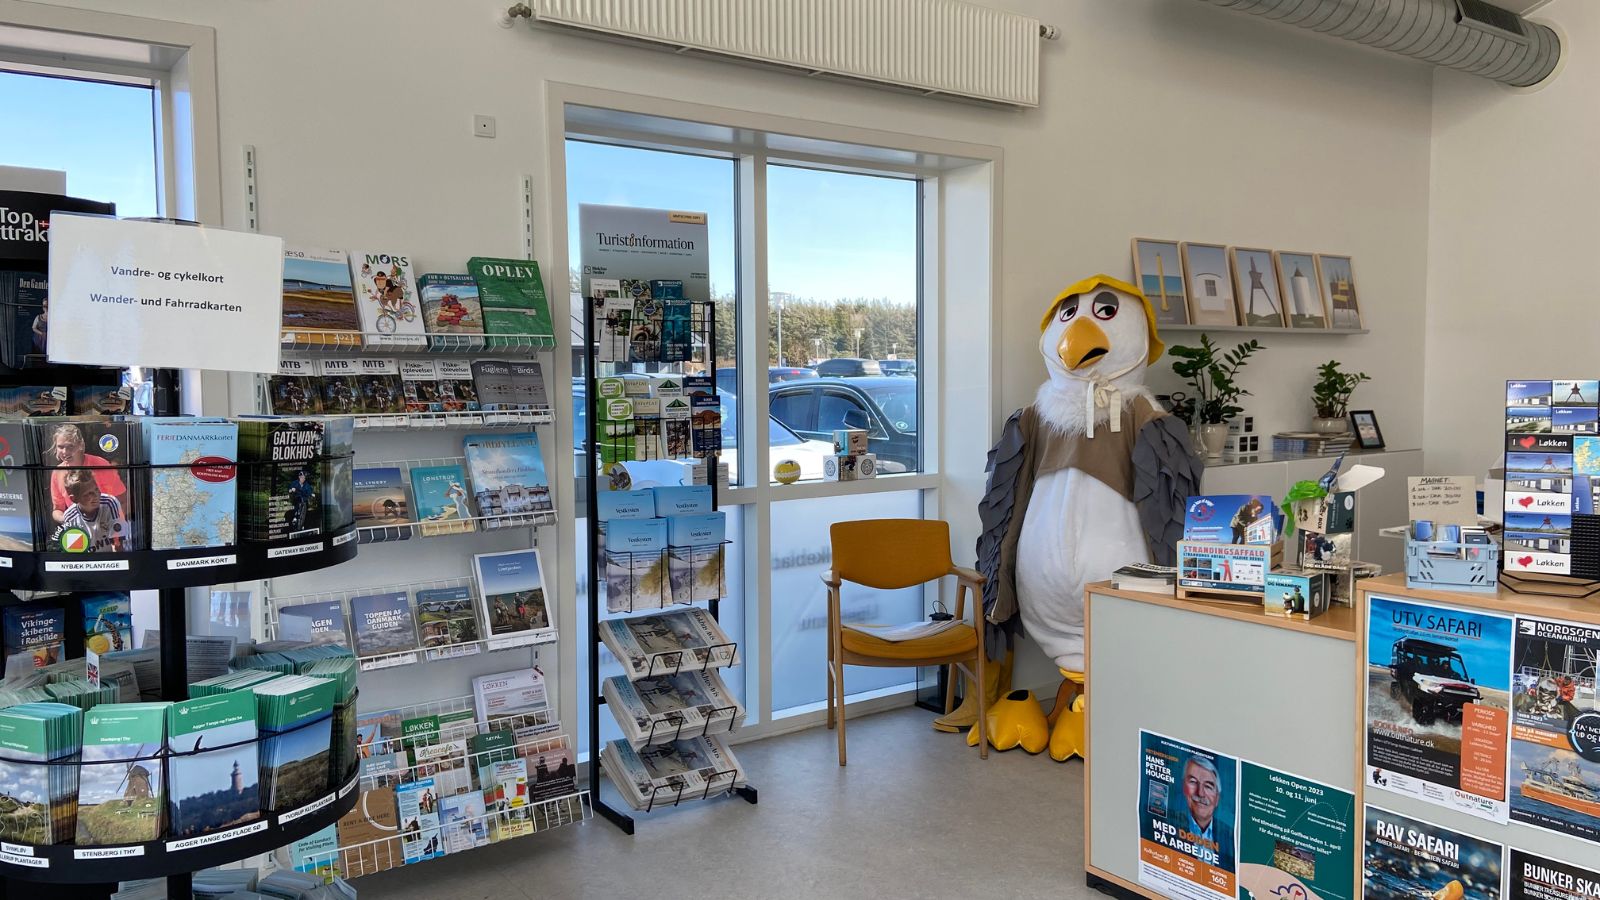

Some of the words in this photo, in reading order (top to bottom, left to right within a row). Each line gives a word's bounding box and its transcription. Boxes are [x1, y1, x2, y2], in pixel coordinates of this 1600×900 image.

[0, 220, 49, 242] ttrak
[595, 232, 695, 251] Turistinformation
[365, 254, 409, 267] MORS
[110, 266, 155, 278] Vandre-
[157, 271, 171, 281] og
[173, 271, 224, 284] cykelkort
[482, 264, 534, 278] OPLEV
[90, 293, 138, 305] Wander-
[141, 296, 162, 307] und
[165, 298, 242, 313] Fahrradkarten
[280, 360, 301, 369] MTB
[325, 360, 349, 369] MTB
[362, 360, 385, 368] MTB
[273, 430, 317, 446] GATEWAY
[1538, 439, 1568, 447] Løkken
[272, 445, 315, 461] BLOKHUS
[1537, 499, 1565, 507] Løkken
[274, 547, 299, 556] GATEWAY
[1183, 545, 1265, 557] STRANDINGSAFFALD
[176, 557, 210, 568] DANMARK
[210, 557, 229, 565] KORT
[1536, 559, 1565, 567] Løkken
[364, 611, 392, 619] TOPPEN
[393, 608, 402, 616] AF
[367, 615, 402, 625] DANMARK
[21, 618, 57, 629] Vikinge-
[312, 618, 333, 628] AGEN
[372, 621, 399, 630] GUIDEN
[1392, 609, 1424, 627] UTV
[1426, 615, 1483, 638] SAFARI
[21, 626, 54, 638] skibene
[1537, 623, 1600, 640] NORDSØEN
[1537, 631, 1588, 644] OCEANARIUM
[26, 633, 58, 645] Roskilde
[404, 721, 434, 733] LØKKEN
[1373, 727, 1436, 748] www.outnature.dk
[1145, 754, 1165, 766] HANS
[1145, 761, 1171, 776] PETTER
[1145, 768, 1175, 784] HOUGEN
[1269, 774, 1291, 786] Løkken
[1290, 781, 1308, 792] Open
[1308, 786, 1325, 796] 2023
[1275, 786, 1285, 795] 10.
[1285, 790, 1294, 799] og
[1294, 792, 1304, 800] 11.
[1304, 795, 1317, 805] juni
[1454, 790, 1494, 806] Outnature
[1152, 818, 1177, 836] MED
[174, 839, 199, 849] AGGER
[199, 834, 221, 844] TANGE
[232, 827, 252, 838] FLADE
[252, 824, 261, 832] SØ
[1376, 819, 1405, 842] RAV
[1407, 829, 1460, 861] SAFARI
[81, 850, 117, 858] STENBJERG
[1153, 830, 1169, 846] PÅ
[1169, 839, 1220, 865] ARBEJDE
[1375, 837, 1394, 849] AMBER
[1393, 841, 1410, 853] SAFARI
[1413, 849, 1441, 864] BERNSTEIN
[1441, 856, 1460, 869] SAFARI
[1523, 861, 1573, 890] BUNKER
